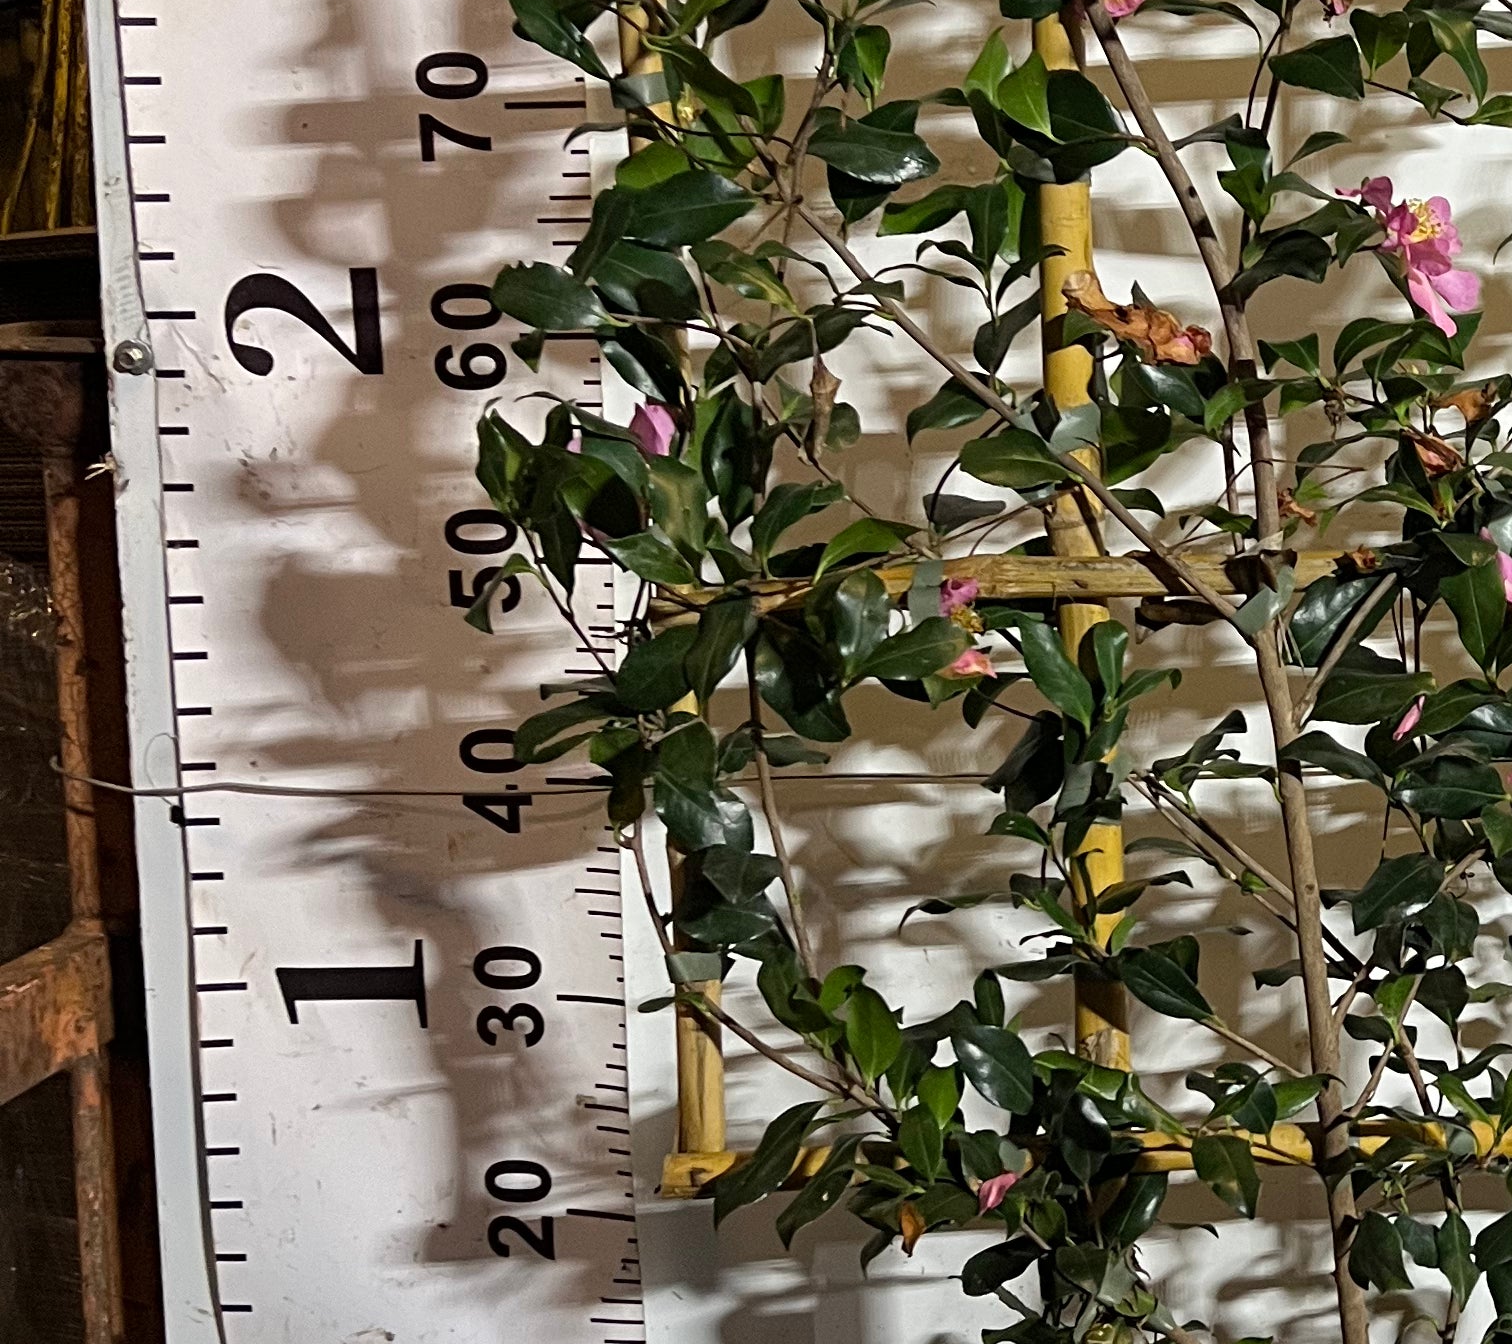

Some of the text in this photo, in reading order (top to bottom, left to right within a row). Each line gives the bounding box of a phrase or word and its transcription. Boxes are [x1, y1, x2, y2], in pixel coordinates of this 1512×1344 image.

[416, 52, 492, 162] 70
[225, 267, 384, 376] 2
[430, 282, 508, 390] 60
[444, 507, 522, 614] 50
[459, 726, 531, 834] 40
[276, 940, 428, 1028] 1
[473, 946, 545, 1047] 30
[485, 1160, 556, 1260] 20
